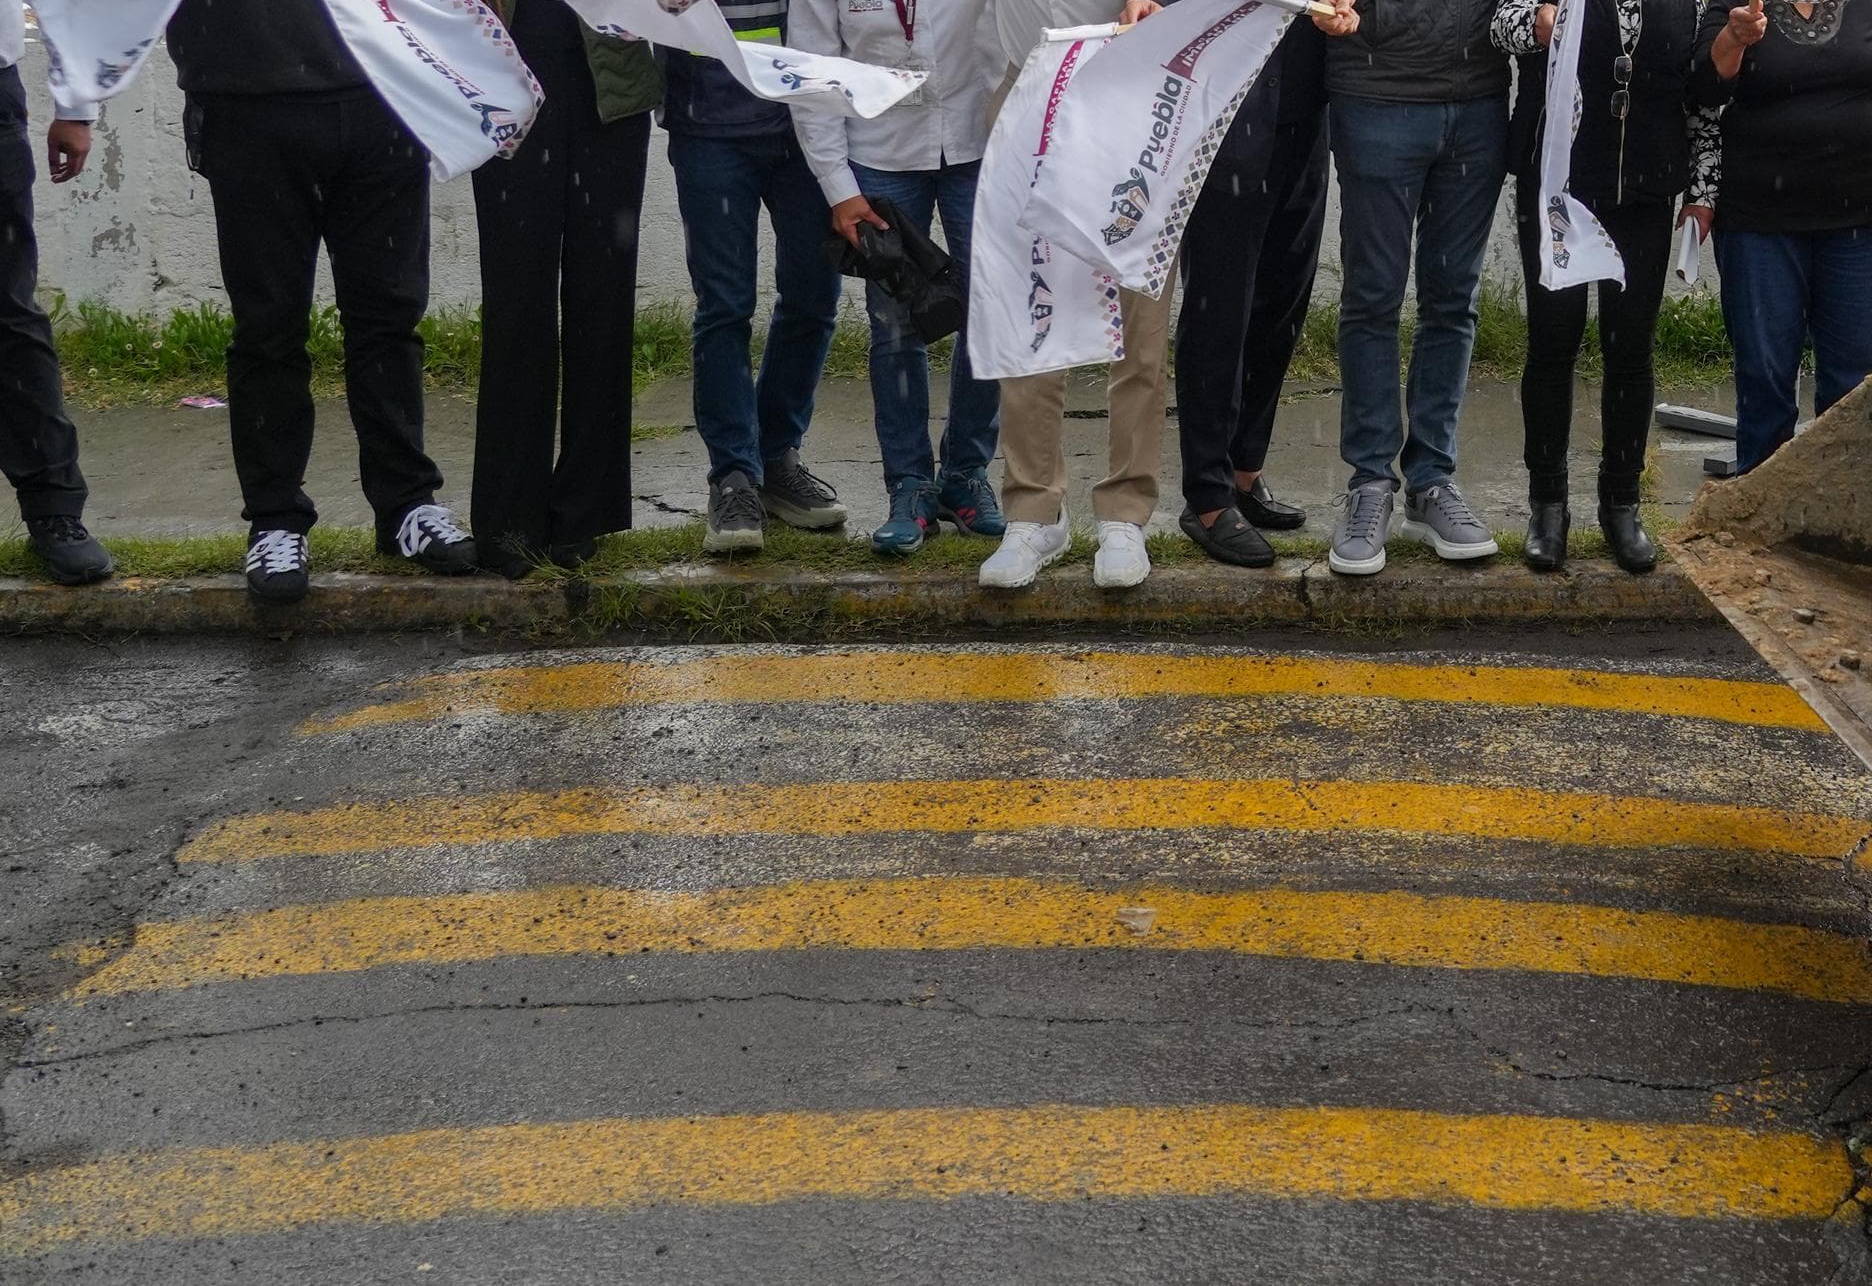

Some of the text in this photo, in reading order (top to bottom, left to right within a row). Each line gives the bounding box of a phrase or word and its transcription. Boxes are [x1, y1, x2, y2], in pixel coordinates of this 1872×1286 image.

[396, 25, 481, 99] Puebla
[1138, 75, 1183, 173] Puebla
[1160, 84, 1192, 176] GOBIERNO DE LA CIUDAD
